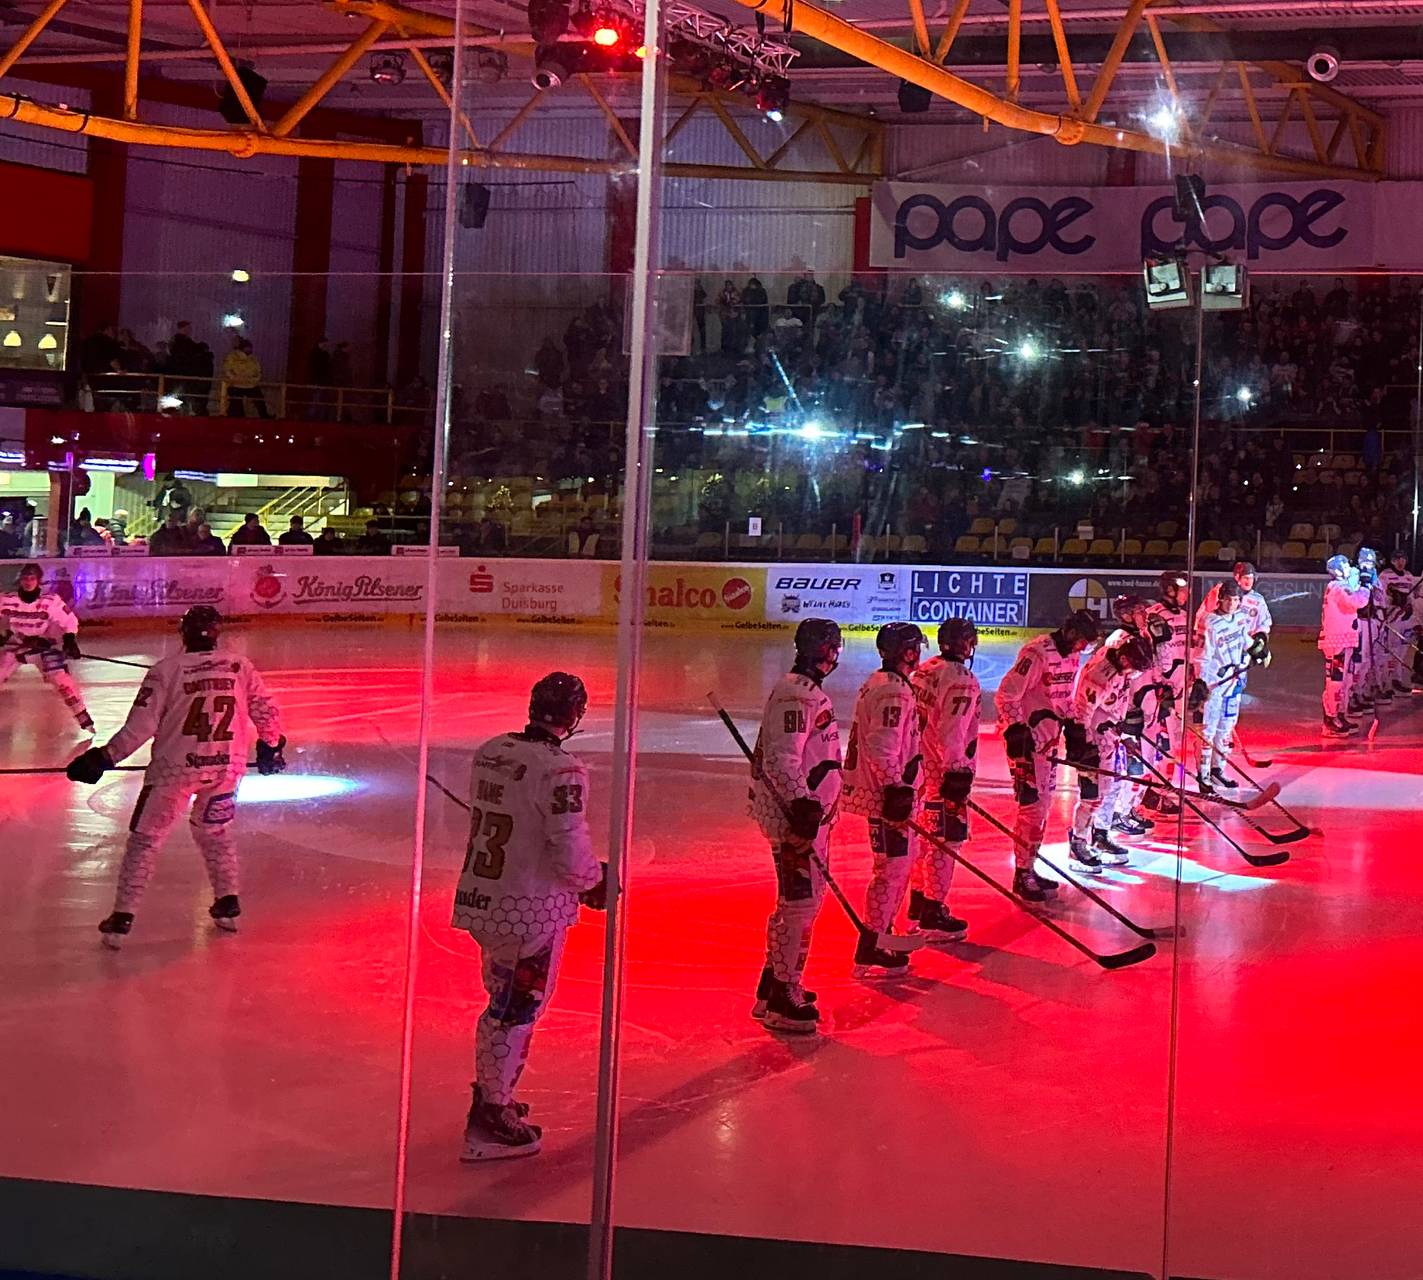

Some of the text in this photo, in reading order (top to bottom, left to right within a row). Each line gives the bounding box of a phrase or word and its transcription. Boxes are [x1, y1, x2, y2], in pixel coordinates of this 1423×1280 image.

[894, 194, 1096, 262] pape
[1140, 189, 1348, 260] pape
[292, 575, 424, 603] König Pilsener
[503, 581, 564, 594] Sparkasse
[913, 573, 1026, 595] LICHTE
[502, 597, 557, 611] Duisburg
[918, 600, 1018, 622] CONTAINER
[882, 706, 902, 728] 13
[951, 697, 973, 717] 77
[182, 695, 236, 743] 42
